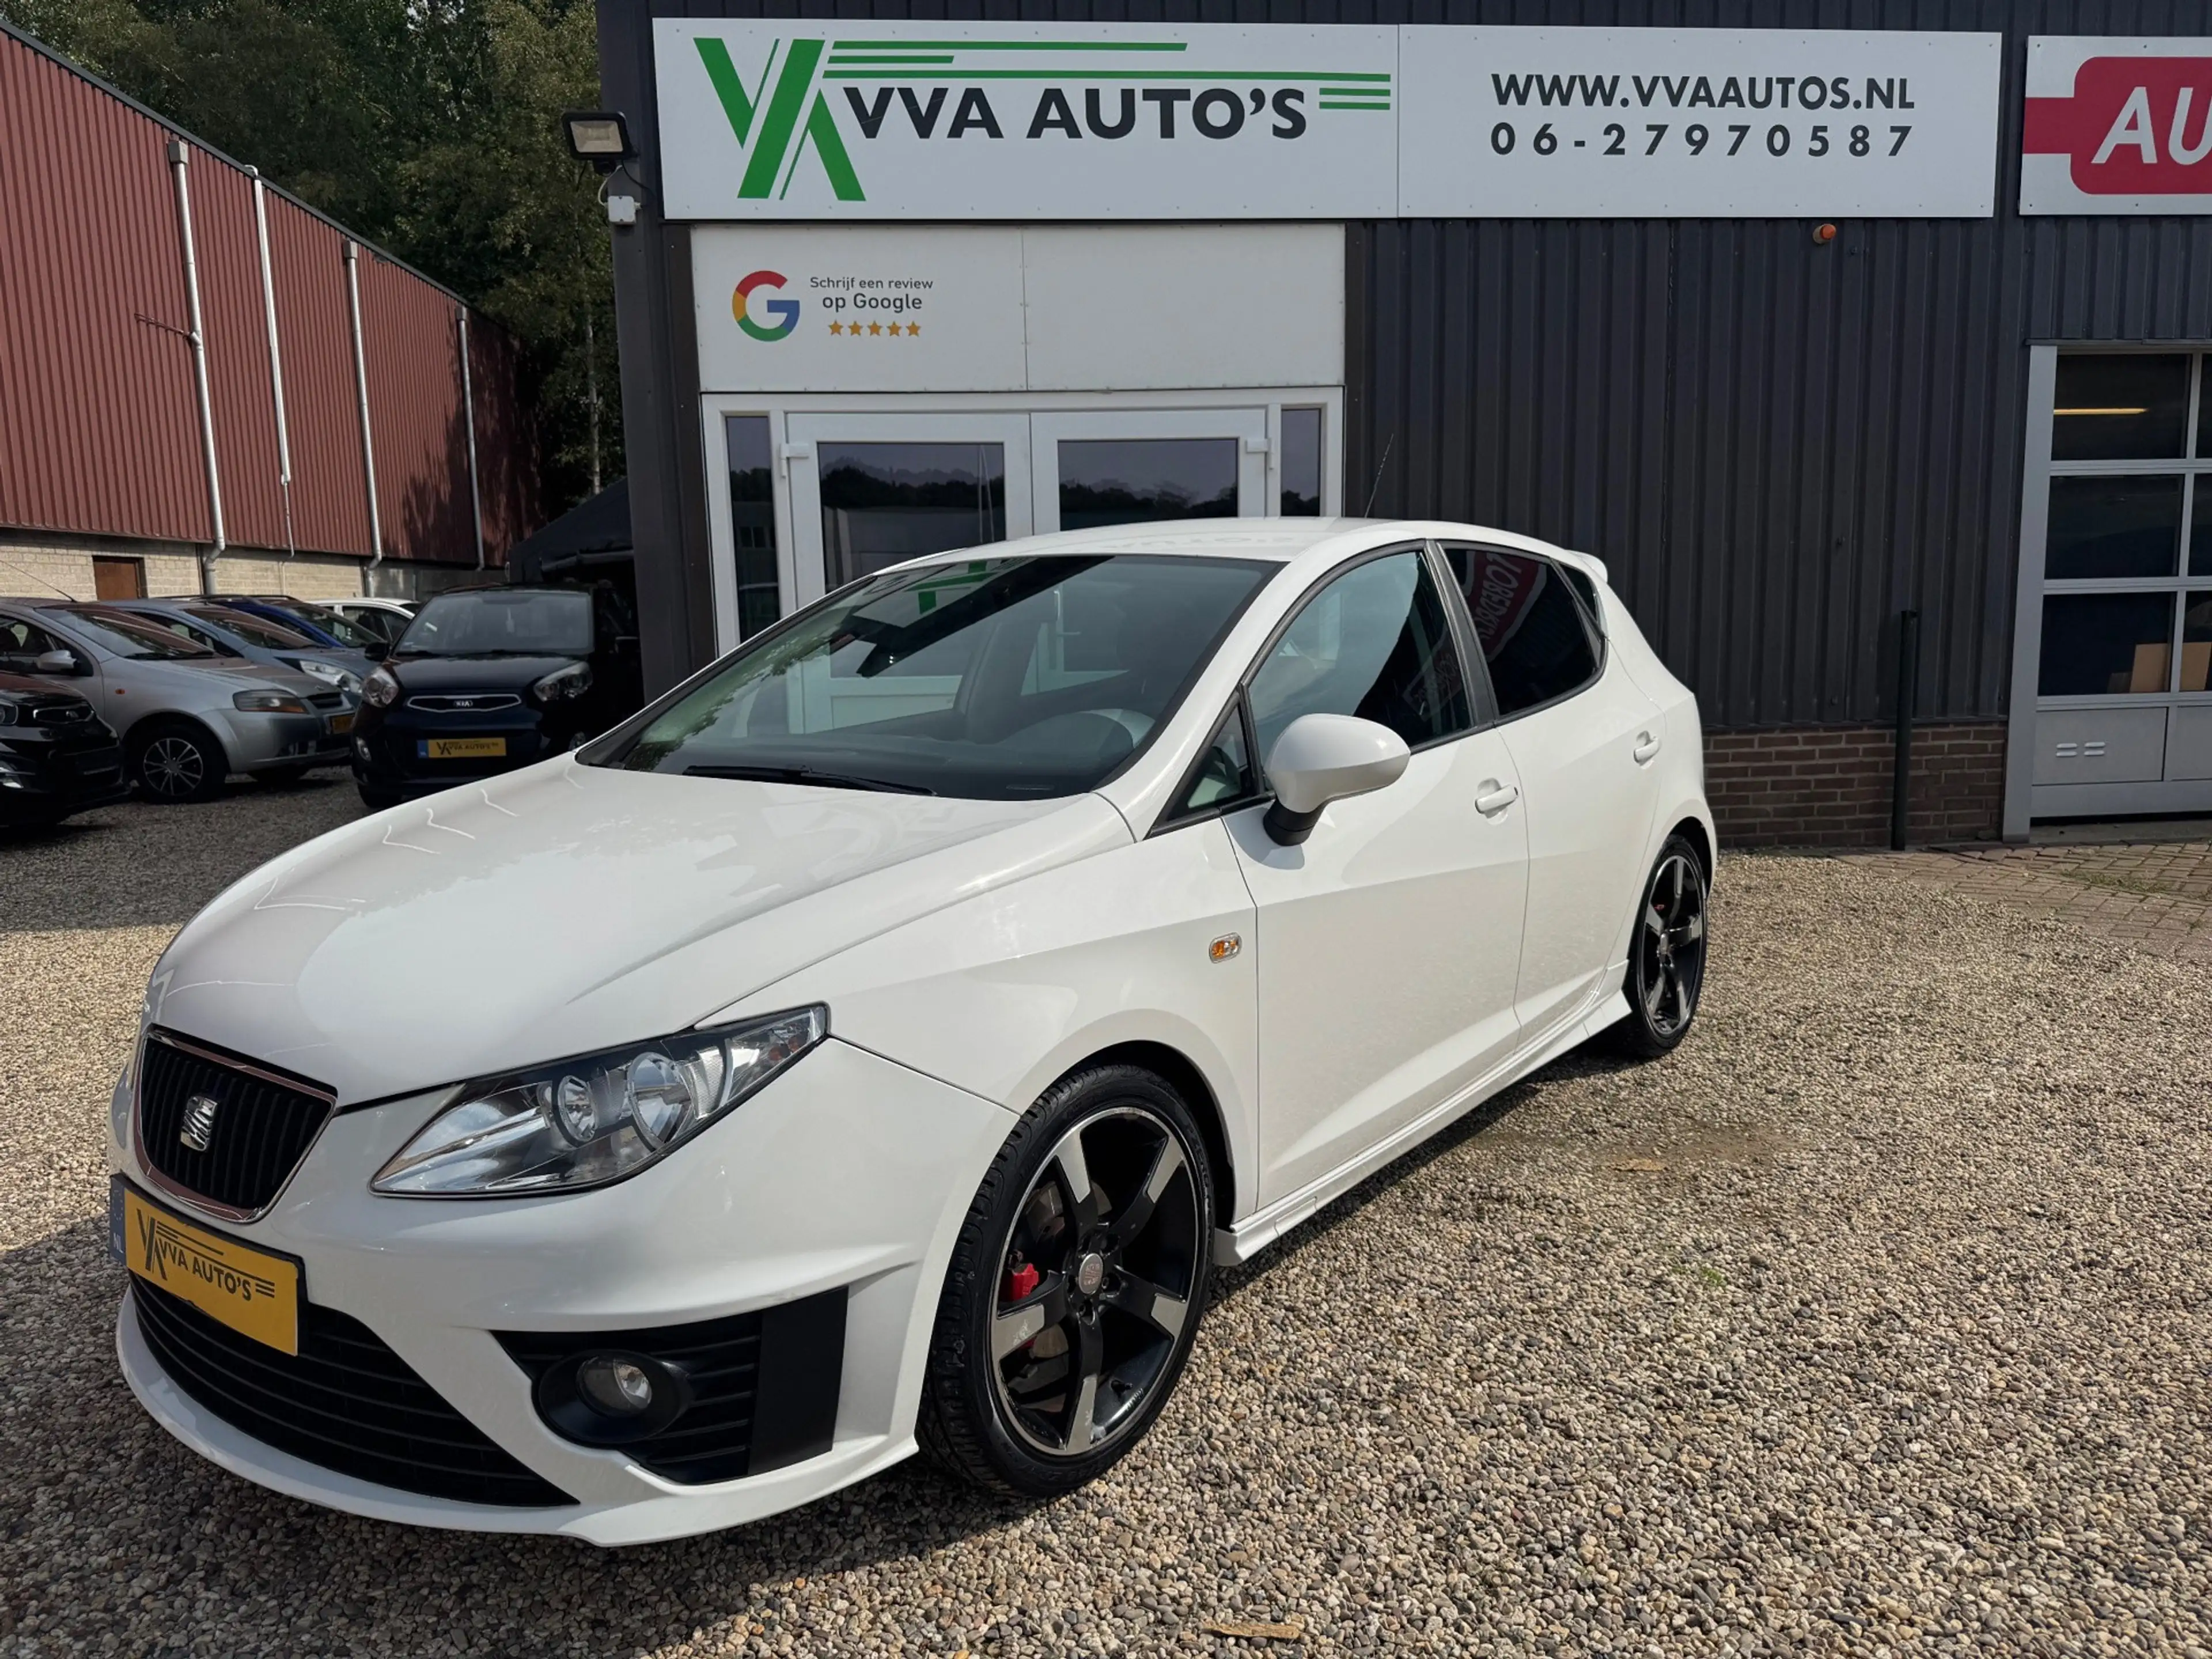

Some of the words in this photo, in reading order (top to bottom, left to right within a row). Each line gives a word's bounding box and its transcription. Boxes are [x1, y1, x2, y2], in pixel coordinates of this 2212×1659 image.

[1491, 73, 1915, 111] WWW.VVAAUTOS.NL
[843, 87, 1004, 139] VVA
[1027, 88, 1307, 140] AUTO'S
[1491, 122, 1913, 157] 06-27970587
[809, 276, 855, 291] Schrijf
[858, 279, 884, 289] een
[888, 278, 934, 290] review
[822, 296, 847, 313] op
[853, 292, 922, 314] Google
[158, 1237, 190, 1271] VVA
[192, 1256, 251, 1301] AUTO'S
